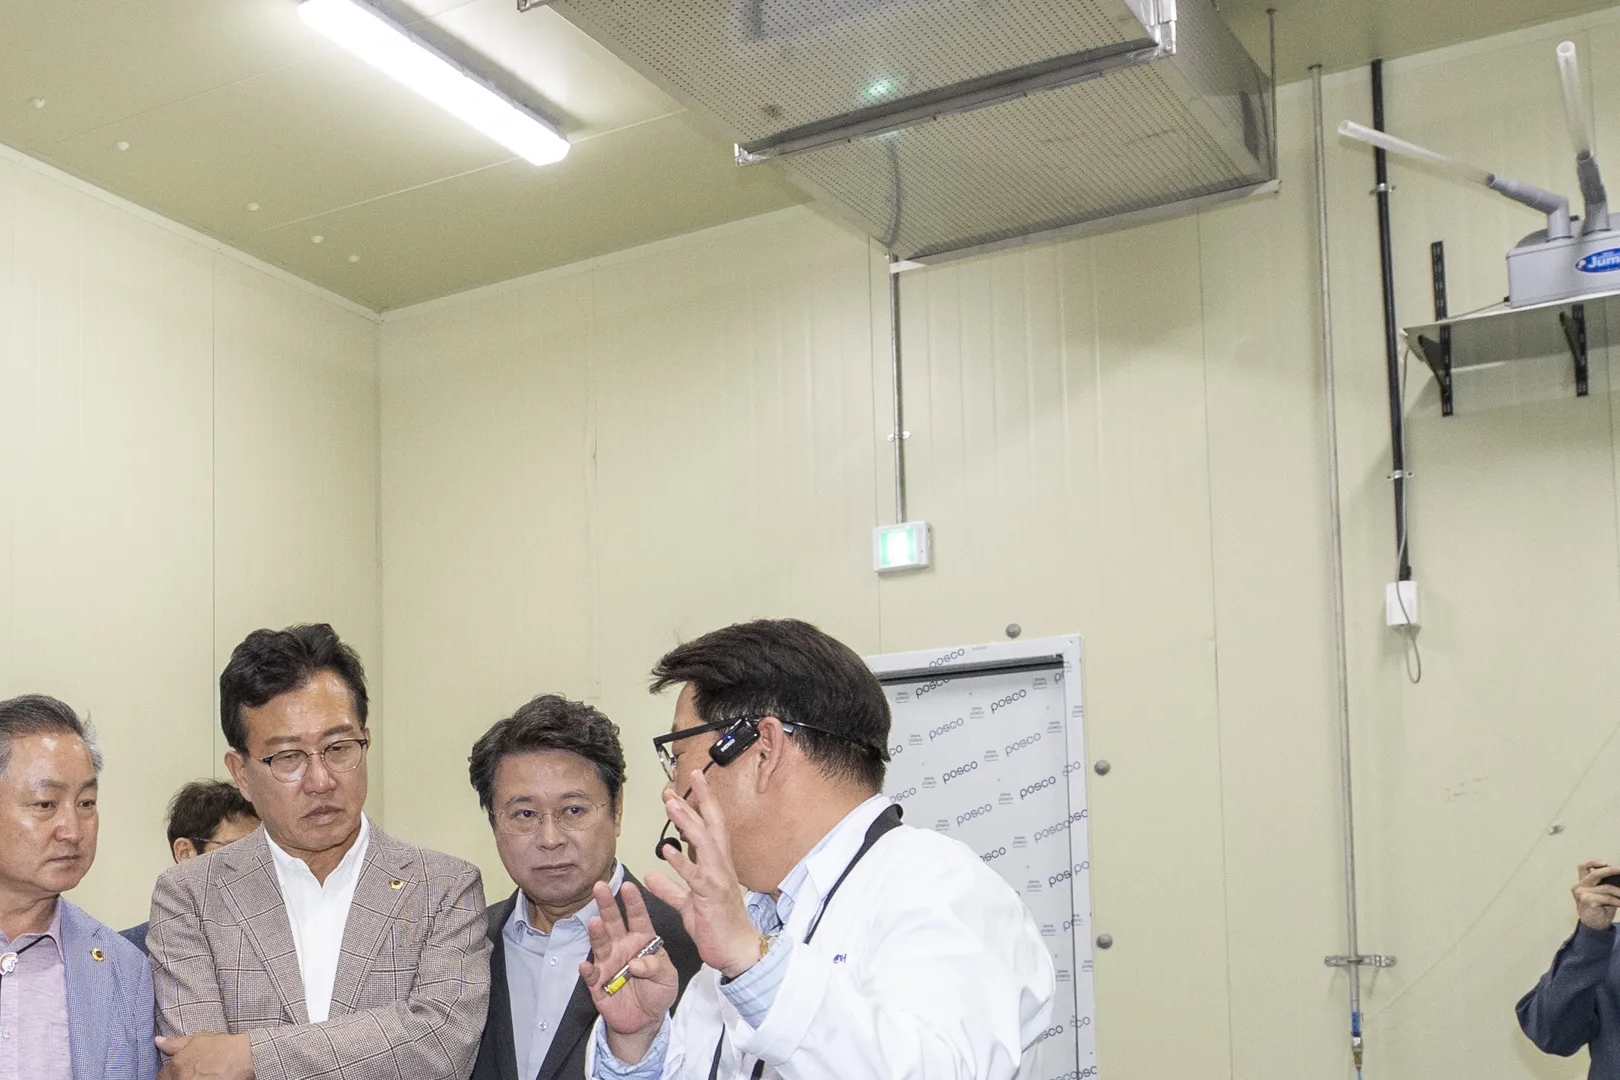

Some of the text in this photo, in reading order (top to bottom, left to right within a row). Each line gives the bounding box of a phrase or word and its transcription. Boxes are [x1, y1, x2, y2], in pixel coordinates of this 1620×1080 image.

[929, 647, 965, 668] posco
[990, 689, 1027, 713] posco
[928, 717, 964, 741] posco
[1004, 732, 1041, 756] posco
[942, 761, 978, 784] posco
[1019, 776, 1056, 800] posco
[956, 803, 992, 827] posco
[1034, 820, 1070, 844] posco
